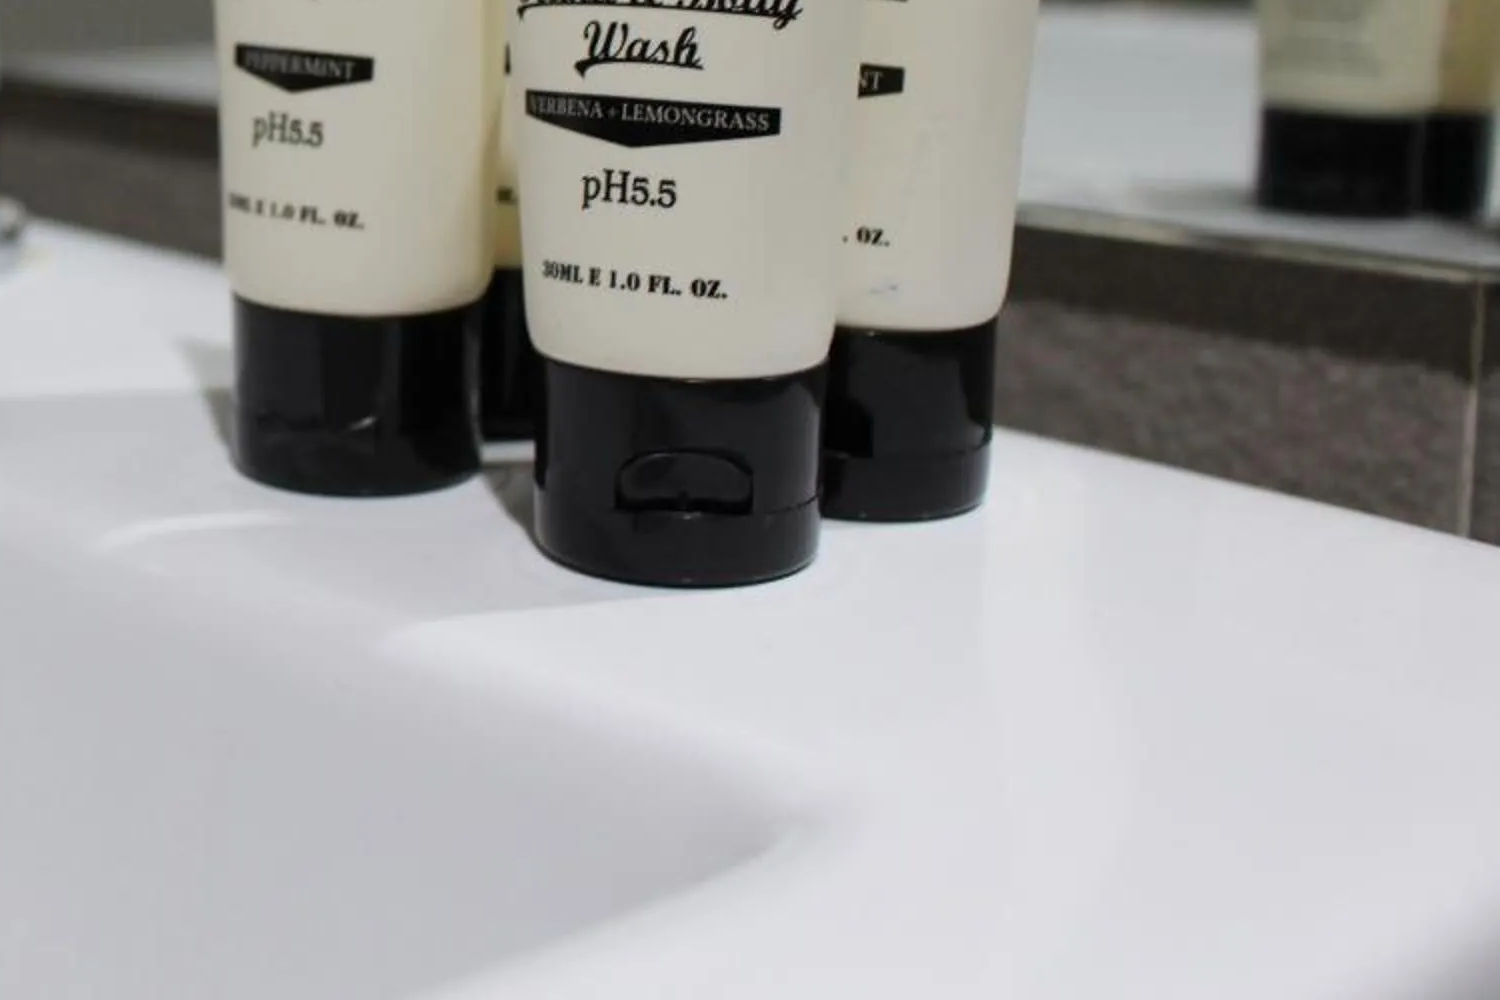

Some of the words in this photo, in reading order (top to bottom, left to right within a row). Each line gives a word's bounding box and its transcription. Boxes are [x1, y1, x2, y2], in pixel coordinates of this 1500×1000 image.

[574, 20, 704, 78] Wash
[252, 110, 324, 148] pH5.5
[620, 102, 770, 131] LEMONGRASS
[581, 168, 677, 210] pH5.5
[542, 260, 584, 285] 30ML
[589, 267, 602, 287] E
[609, 269, 641, 292] 1.0
[647, 274, 682, 297] FL.
[690, 278, 728, 300] OZ.
